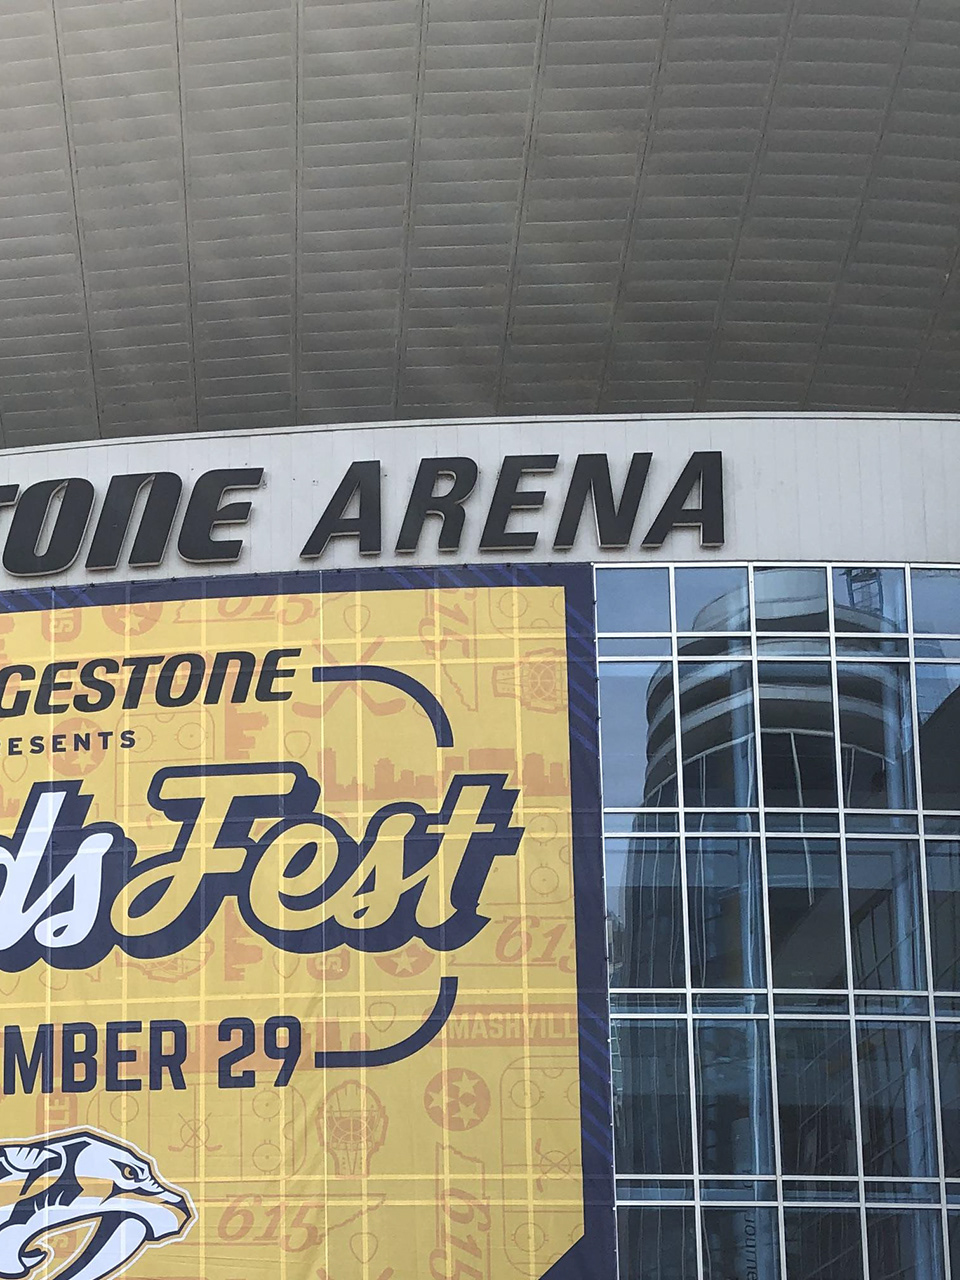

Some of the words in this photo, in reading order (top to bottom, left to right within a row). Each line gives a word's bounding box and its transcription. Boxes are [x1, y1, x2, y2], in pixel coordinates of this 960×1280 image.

[299, 450, 726, 560] ARENA
[217, 1014, 303, 1090] 29
[444, 1010, 578, 1040] MASHVILL
